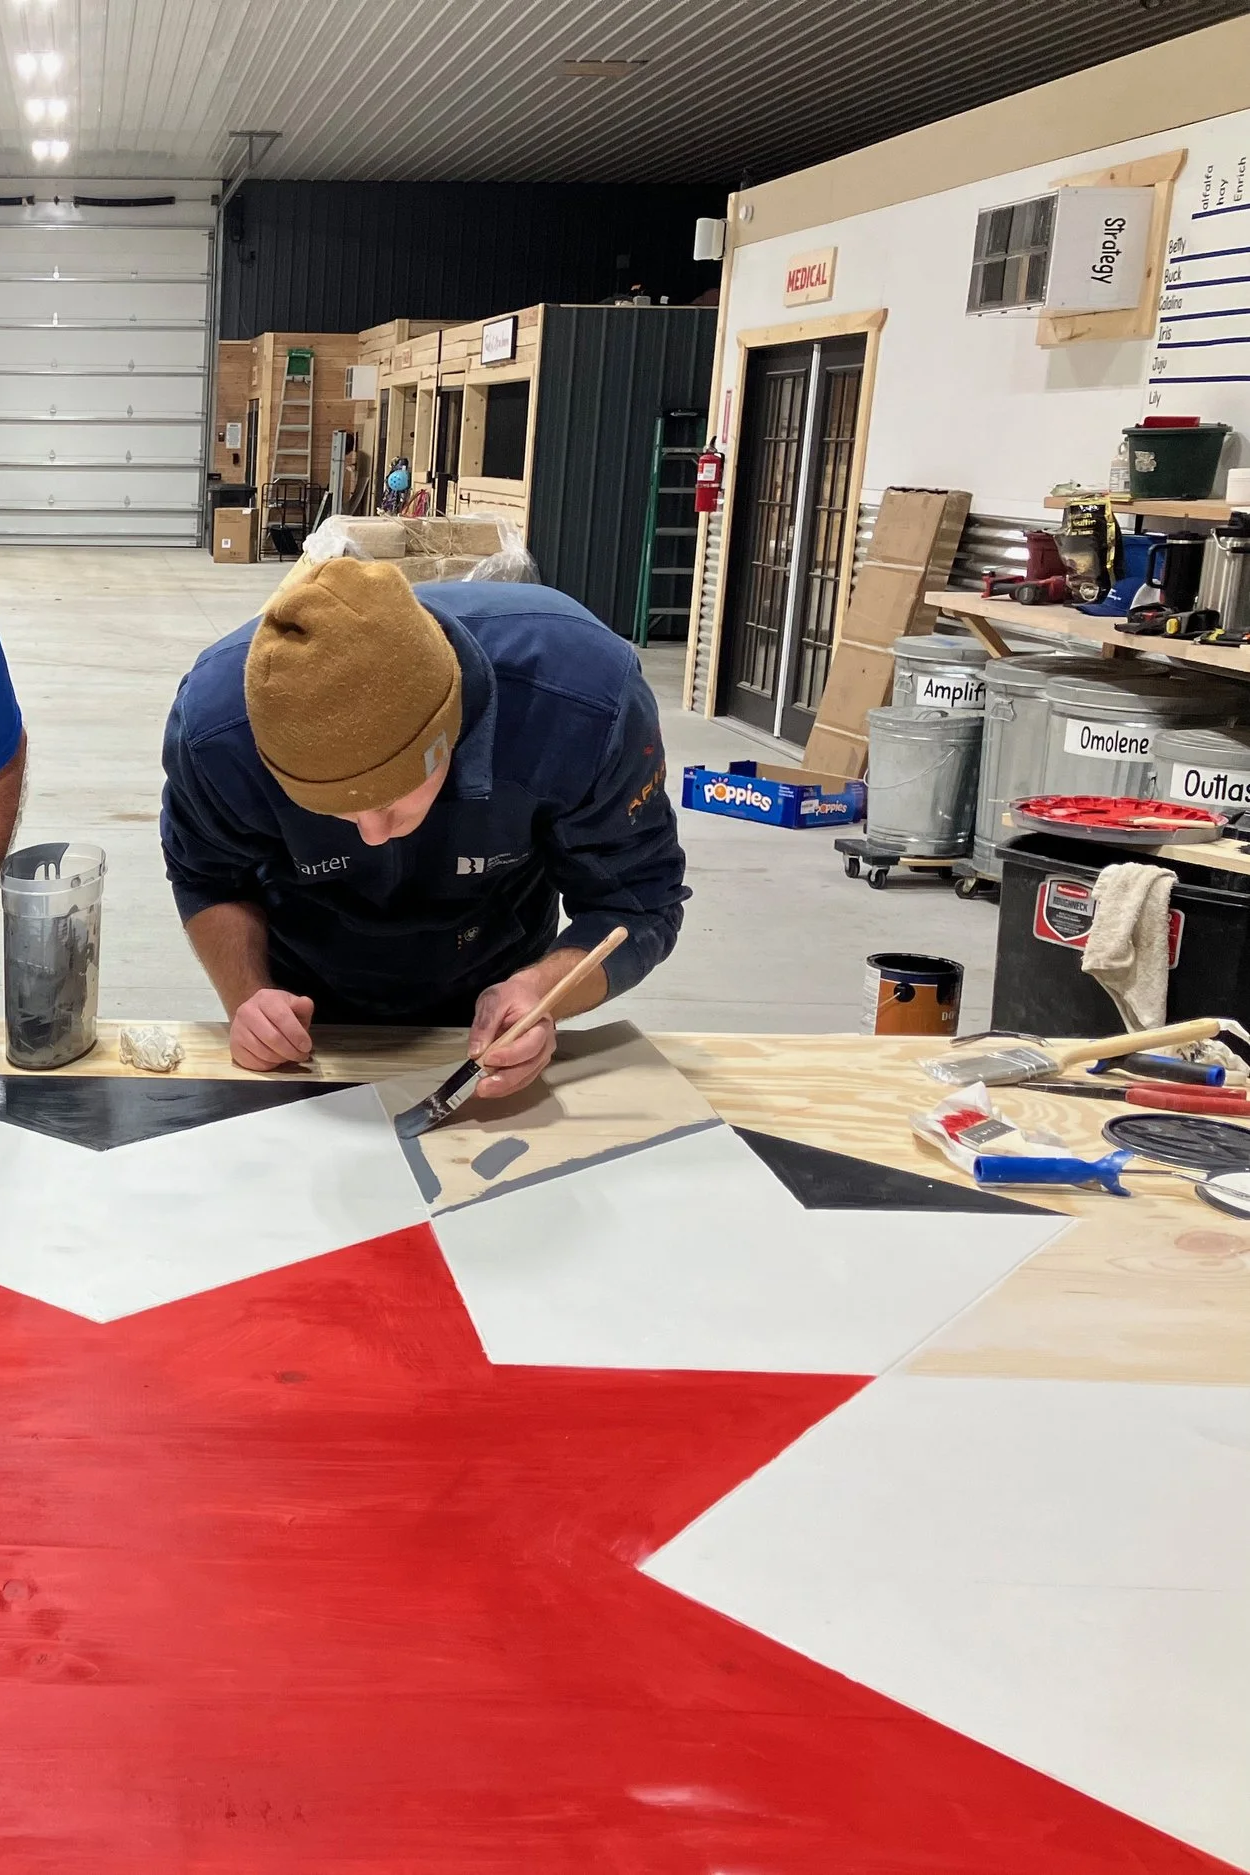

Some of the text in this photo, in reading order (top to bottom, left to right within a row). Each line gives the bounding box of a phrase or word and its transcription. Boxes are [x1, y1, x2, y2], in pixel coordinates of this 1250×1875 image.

[1201, 165, 1214, 210] alfalfa
[1216, 179, 1229, 206] hay
[1233, 157, 1247, 202] Enrich
[1090, 217, 1126, 284] Strategy
[786, 262, 827, 293] MEDICAL
[1164, 266, 1181, 284] Buck
[1159, 326, 1172, 341] Iris
[924, 679, 986, 708] Amplif
[1081, 726, 1149, 754] Omolene
[704, 783, 772, 811] poppies
